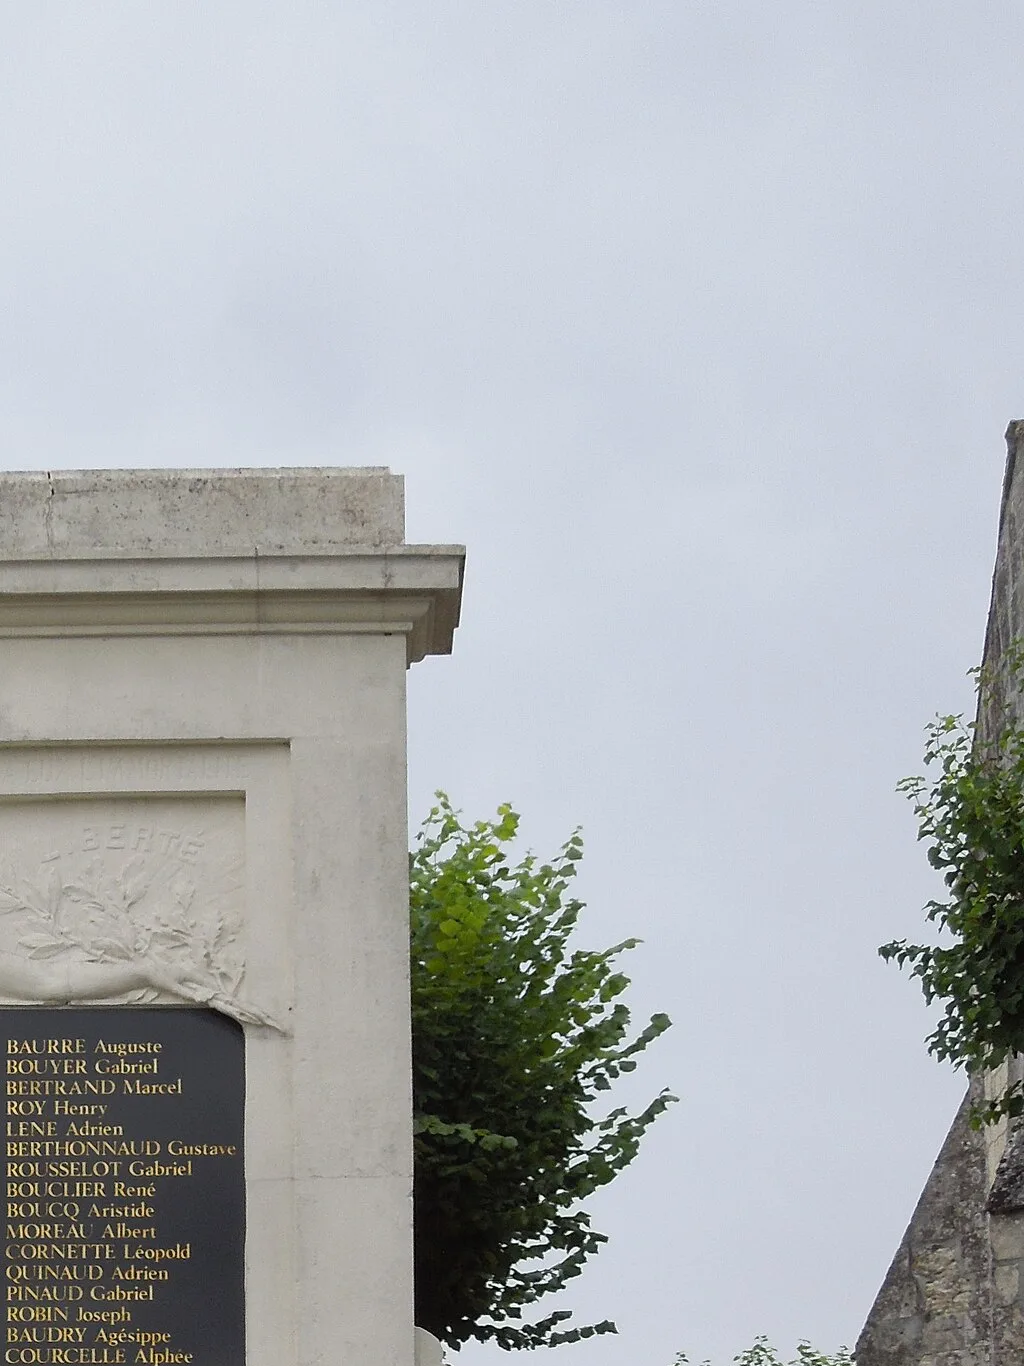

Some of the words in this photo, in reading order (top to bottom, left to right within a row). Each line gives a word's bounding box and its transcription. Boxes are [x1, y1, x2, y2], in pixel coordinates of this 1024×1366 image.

[7, 1039, 86, 1054] BAURRE
[95, 1039, 162, 1057] Auguste
[7, 1059, 87, 1074] BOUYER
[95, 1058, 157, 1074] Gabriel
[7, 1080, 115, 1095] BERTRAND
[123, 1079, 181, 1094] Marcel
[7, 1101, 46, 1115] ROY
[55, 1101, 107, 1117] Henry
[66, 1121, 123, 1136] Adrien
[7, 1141, 160, 1156] BERTHONNAUD
[168, 1141, 235, 1155] Gustave
[7, 1161, 122, 1177] ROUSSELOT
[129, 1161, 192, 1176] Gabriel
[7, 1182, 106, 1197] BOUCLIER
[114, 1182, 156, 1196] René
[7, 1202, 79, 1221] BOUCQ
[88, 1202, 154, 1217] Aristide
[6, 1223, 93, 1239] MOREAU
[102, 1223, 155, 1238] Albert
[6, 1244, 115, 1259] CORNETTE
[125, 1244, 190, 1262] Léopold
[6, 1265, 103, 1284] QUINAUD
[112, 1265, 168, 1280] Adrien
[7, 1286, 83, 1301] PINAUD
[90, 1285, 153, 1300] Gabriel
[7, 1307, 68, 1321] ROBIN
[76, 1306, 130, 1325] Joseph
[7, 1327, 86, 1342] BAUDRY
[95, 1328, 171, 1346] Agésippe
[5, 1348, 126, 1363] COURCELLE
